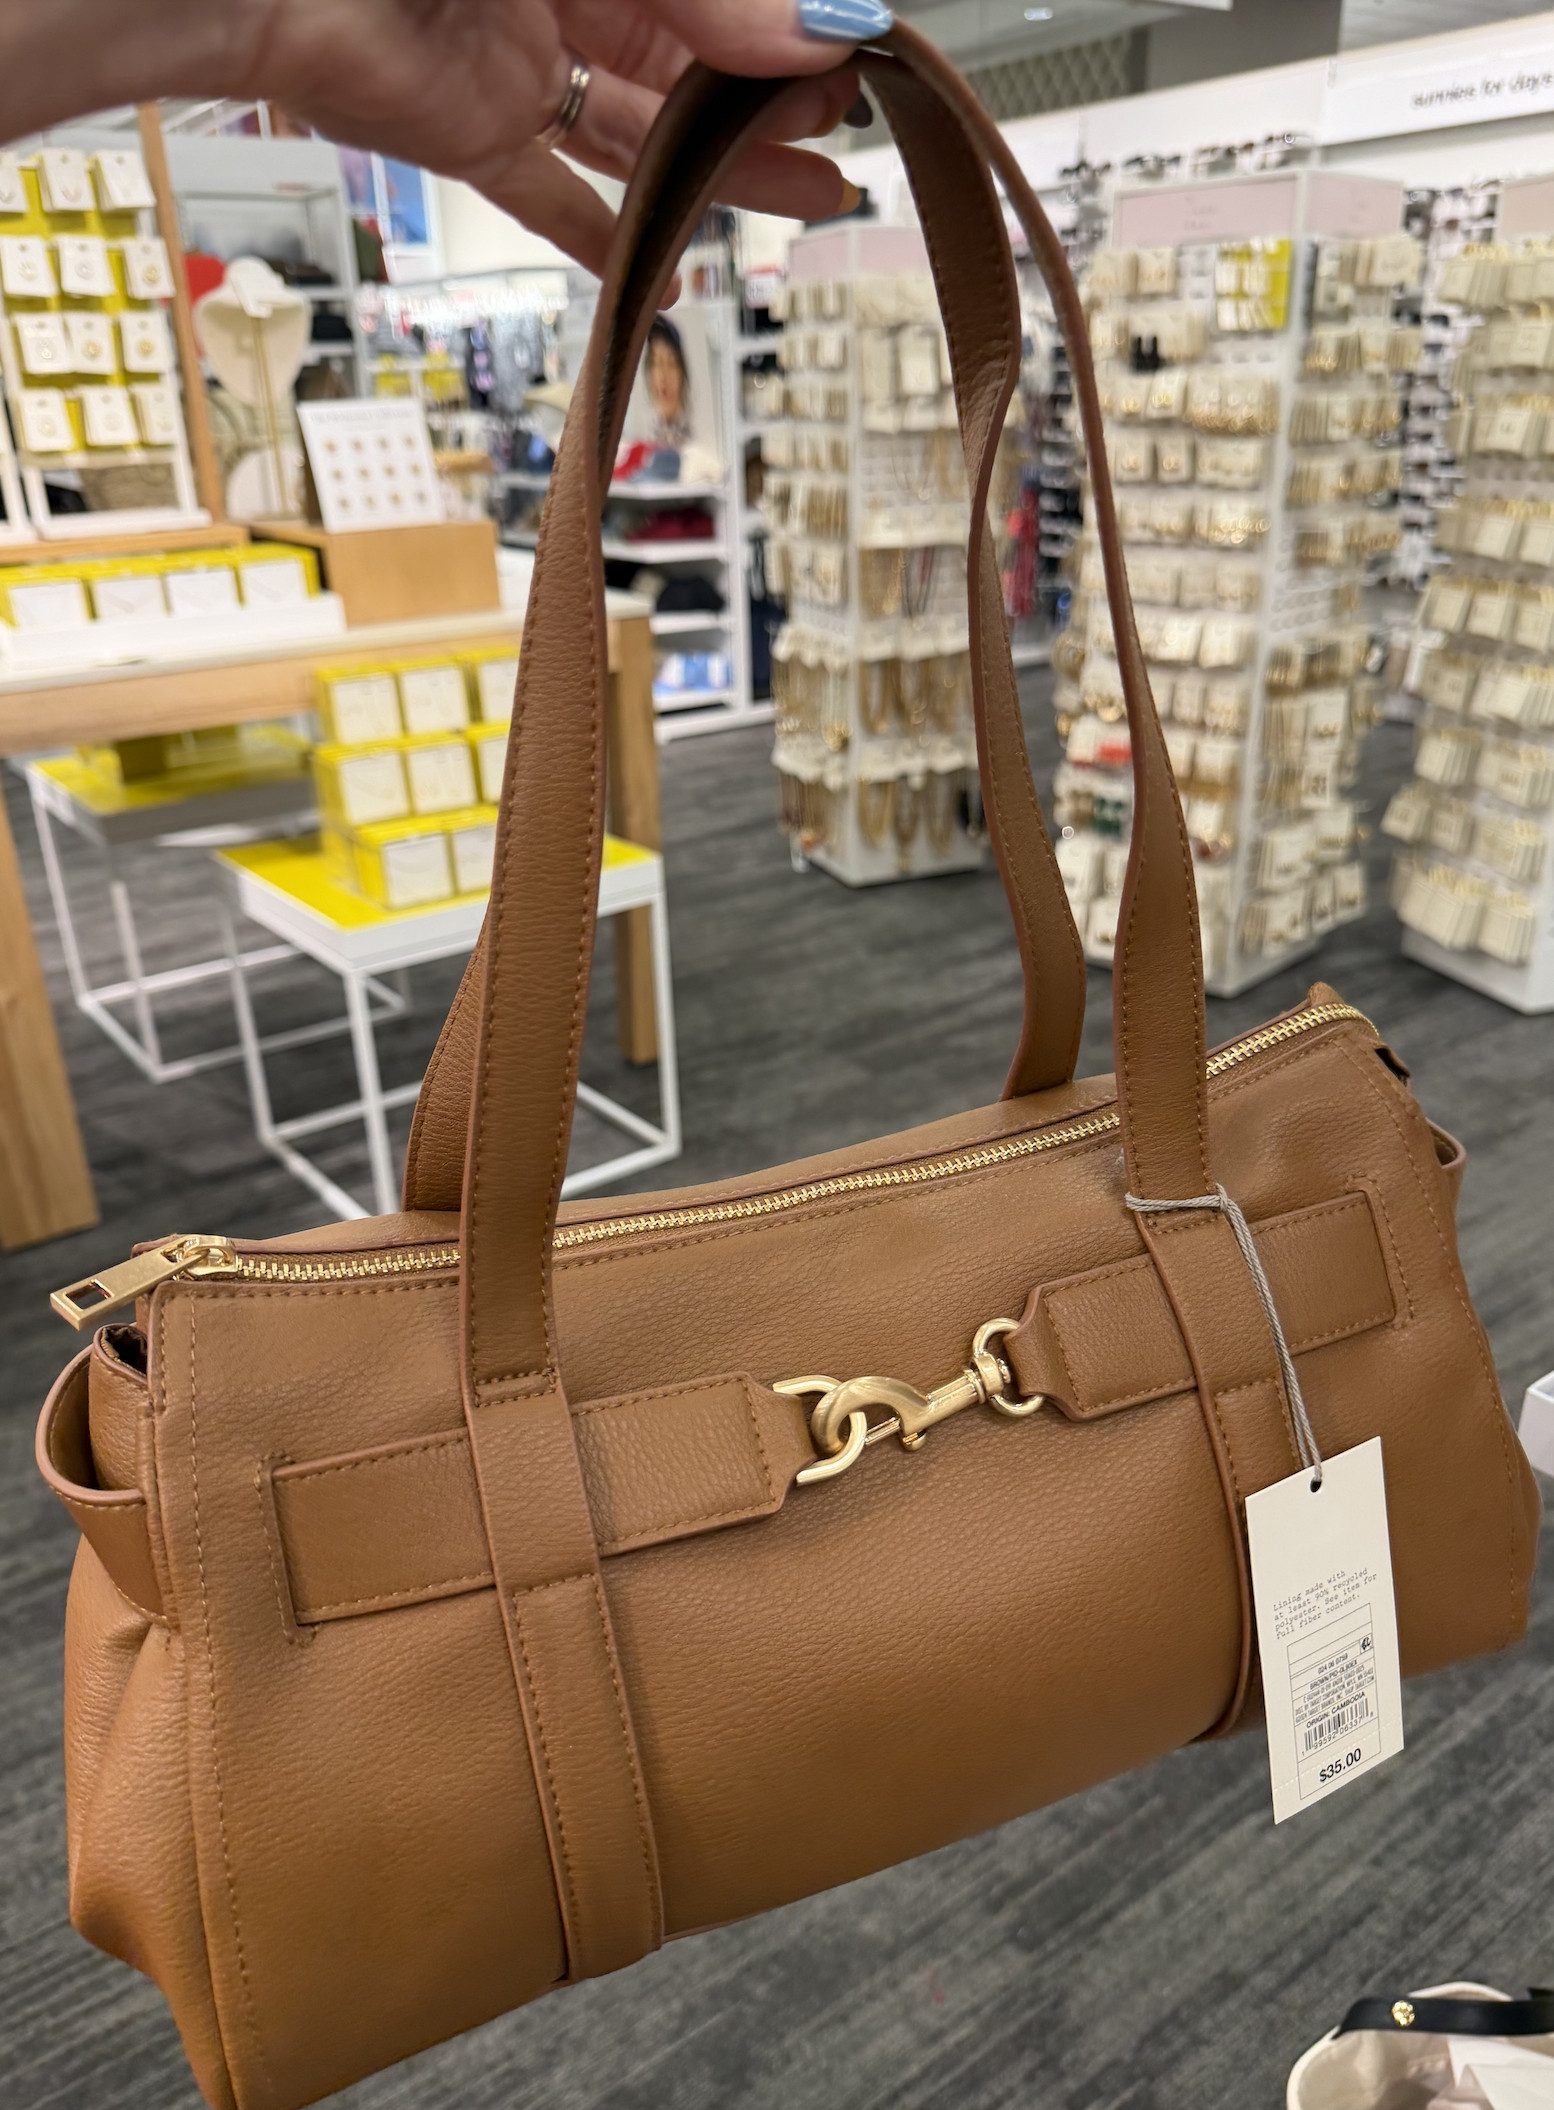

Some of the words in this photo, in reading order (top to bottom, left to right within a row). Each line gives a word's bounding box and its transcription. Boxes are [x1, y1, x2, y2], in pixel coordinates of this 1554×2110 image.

[1273, 1591, 1301, 1613] Lining
[1305, 1580, 1323, 1595] made
[1327, 1569, 1345, 1584] with
[1274, 1611, 1283, 1621] at
[1288, 1596, 1310, 1614] least
[1314, 1587, 1328, 1600] 90%
[1332, 1568, 1367, 1591] recycled
[1275, 1604, 1320, 1631] polyester.
[1324, 1592, 1338, 1605] See
[1343, 1580, 1359, 1595] item
[1363, 1572, 1376, 1584] for
[1276, 1624, 1294, 1640] full
[1299, 1610, 1321, 1628] fiber
[1325, 1594, 1359, 1613] content.
[1306, 1711, 1329, 1728] ORIGIN:
[1332, 1691, 1365, 1713] CAMBODIA
[1313, 1732, 1336, 1749] 99592
[1319, 1748, 1361, 1782] $35.00
